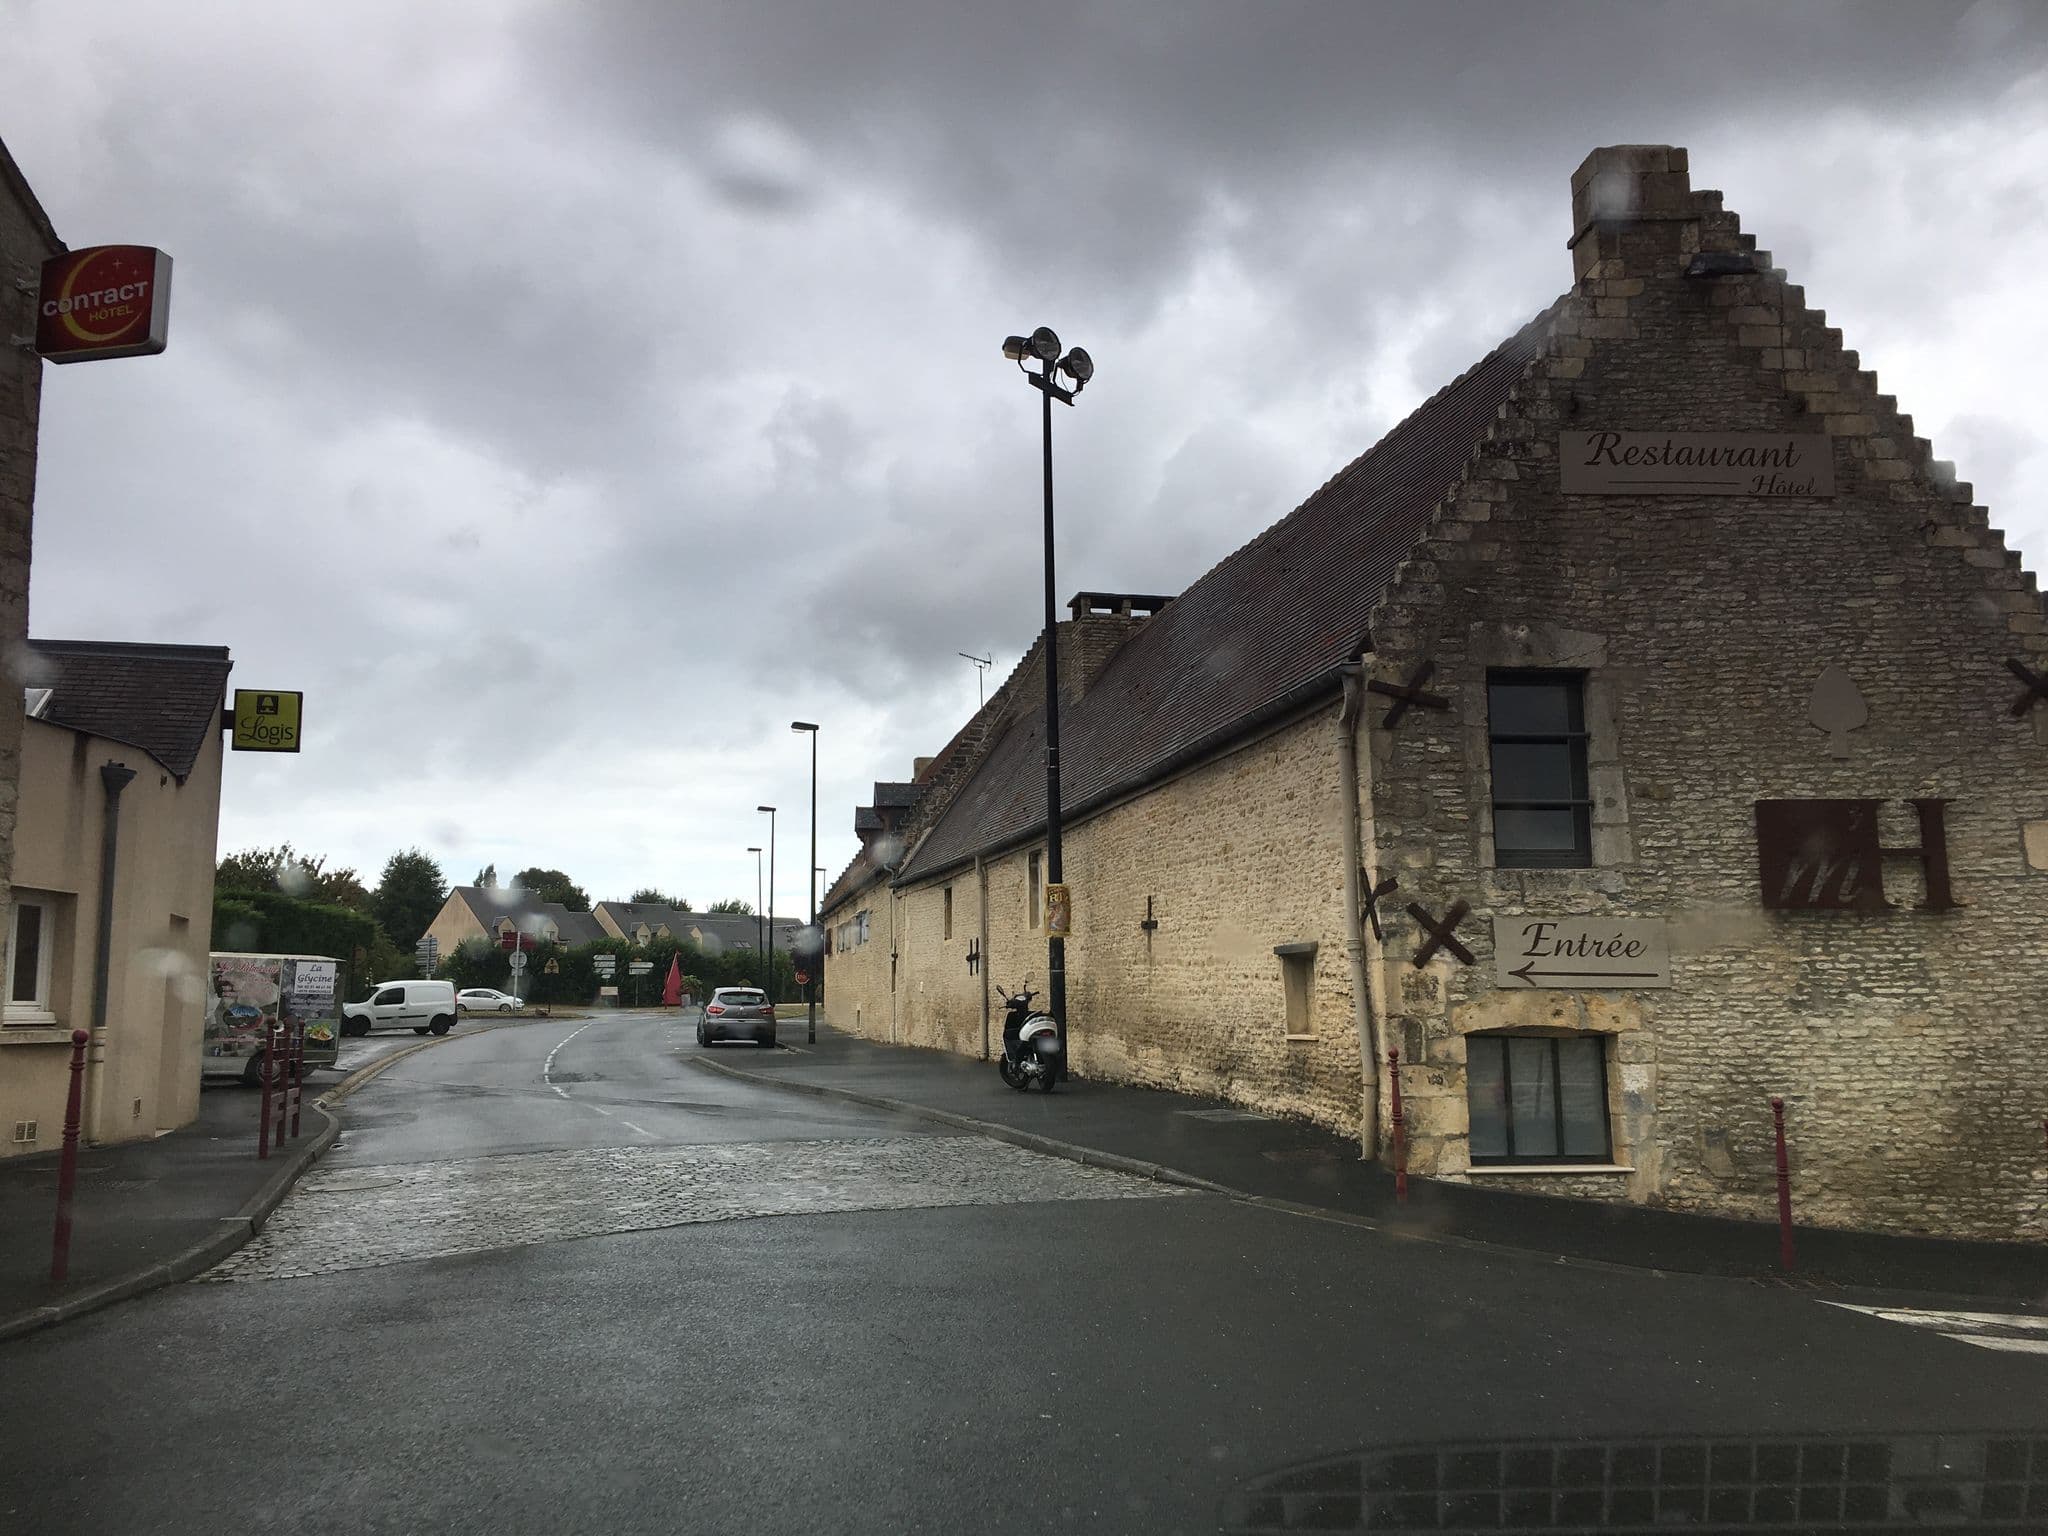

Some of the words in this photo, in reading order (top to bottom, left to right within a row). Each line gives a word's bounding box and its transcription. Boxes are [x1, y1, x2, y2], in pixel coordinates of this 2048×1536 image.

[89, 304, 134, 321] HOTEL
[1584, 432, 1801, 468] Restaurant
[1747, 472, 1817, 495] Hôtel
[238, 716, 294, 745] Logis
[1521, 922, 1648, 958] Entrée
[297, 973, 333, 985] Glycine
[309, 963, 322, 972] La
